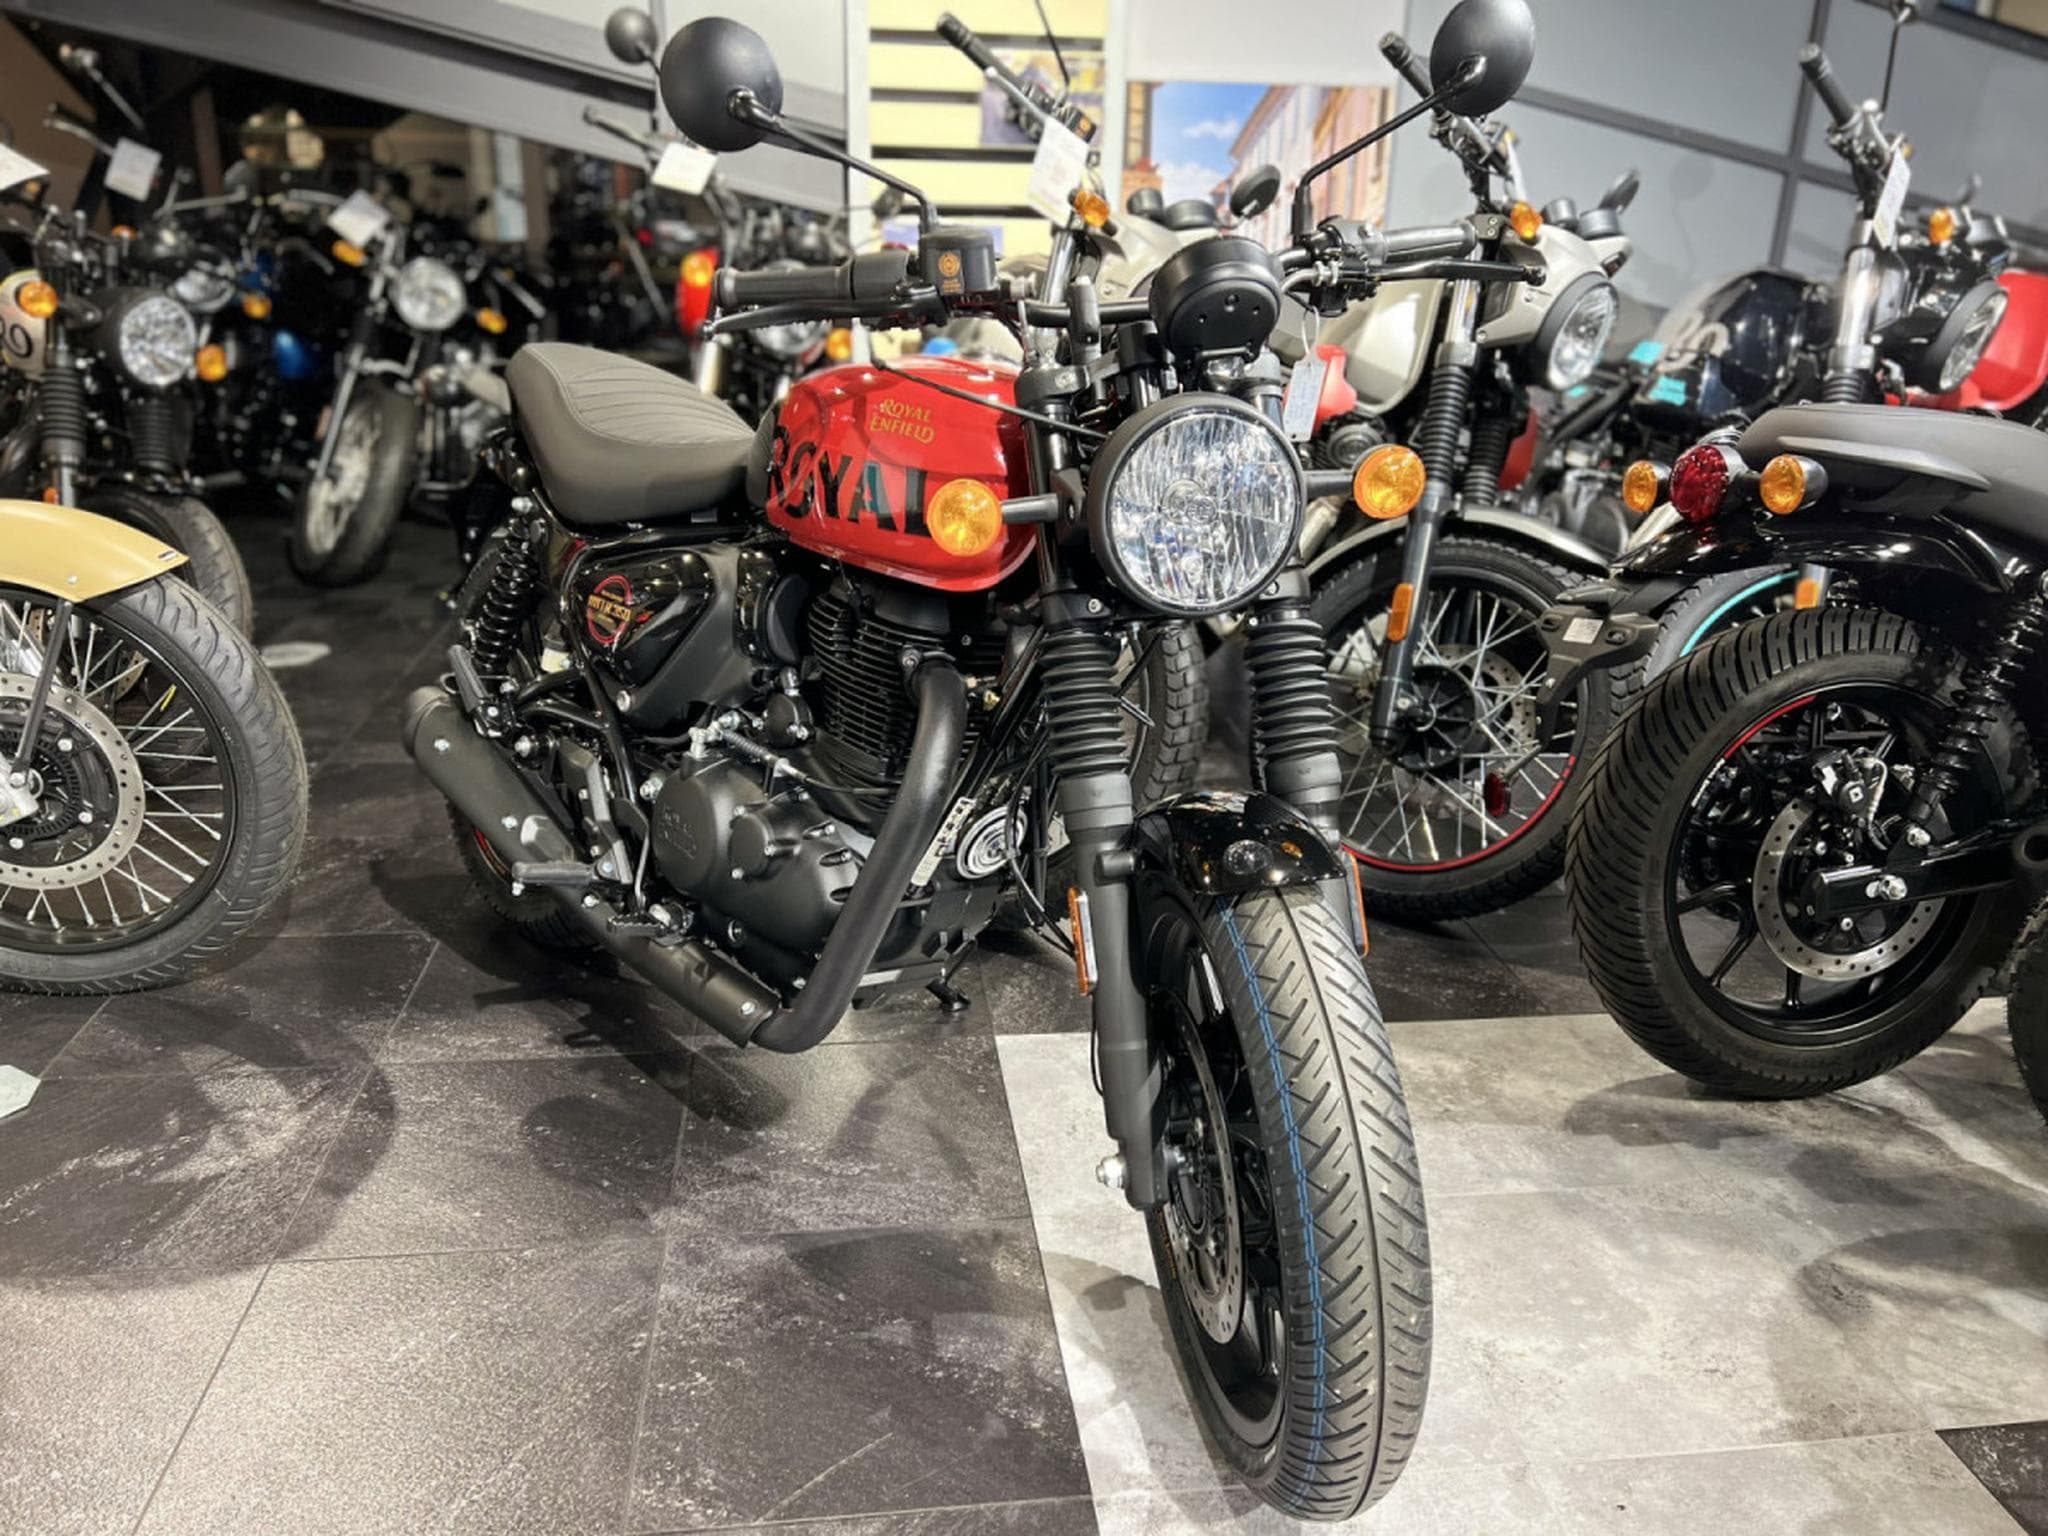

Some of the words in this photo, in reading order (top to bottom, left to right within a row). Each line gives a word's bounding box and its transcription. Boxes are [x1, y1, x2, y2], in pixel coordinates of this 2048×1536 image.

[880, 398, 931, 423] ROYAL
[869, 416, 936, 444] ENFIELD
[767, 426, 933, 538] ROYAL
